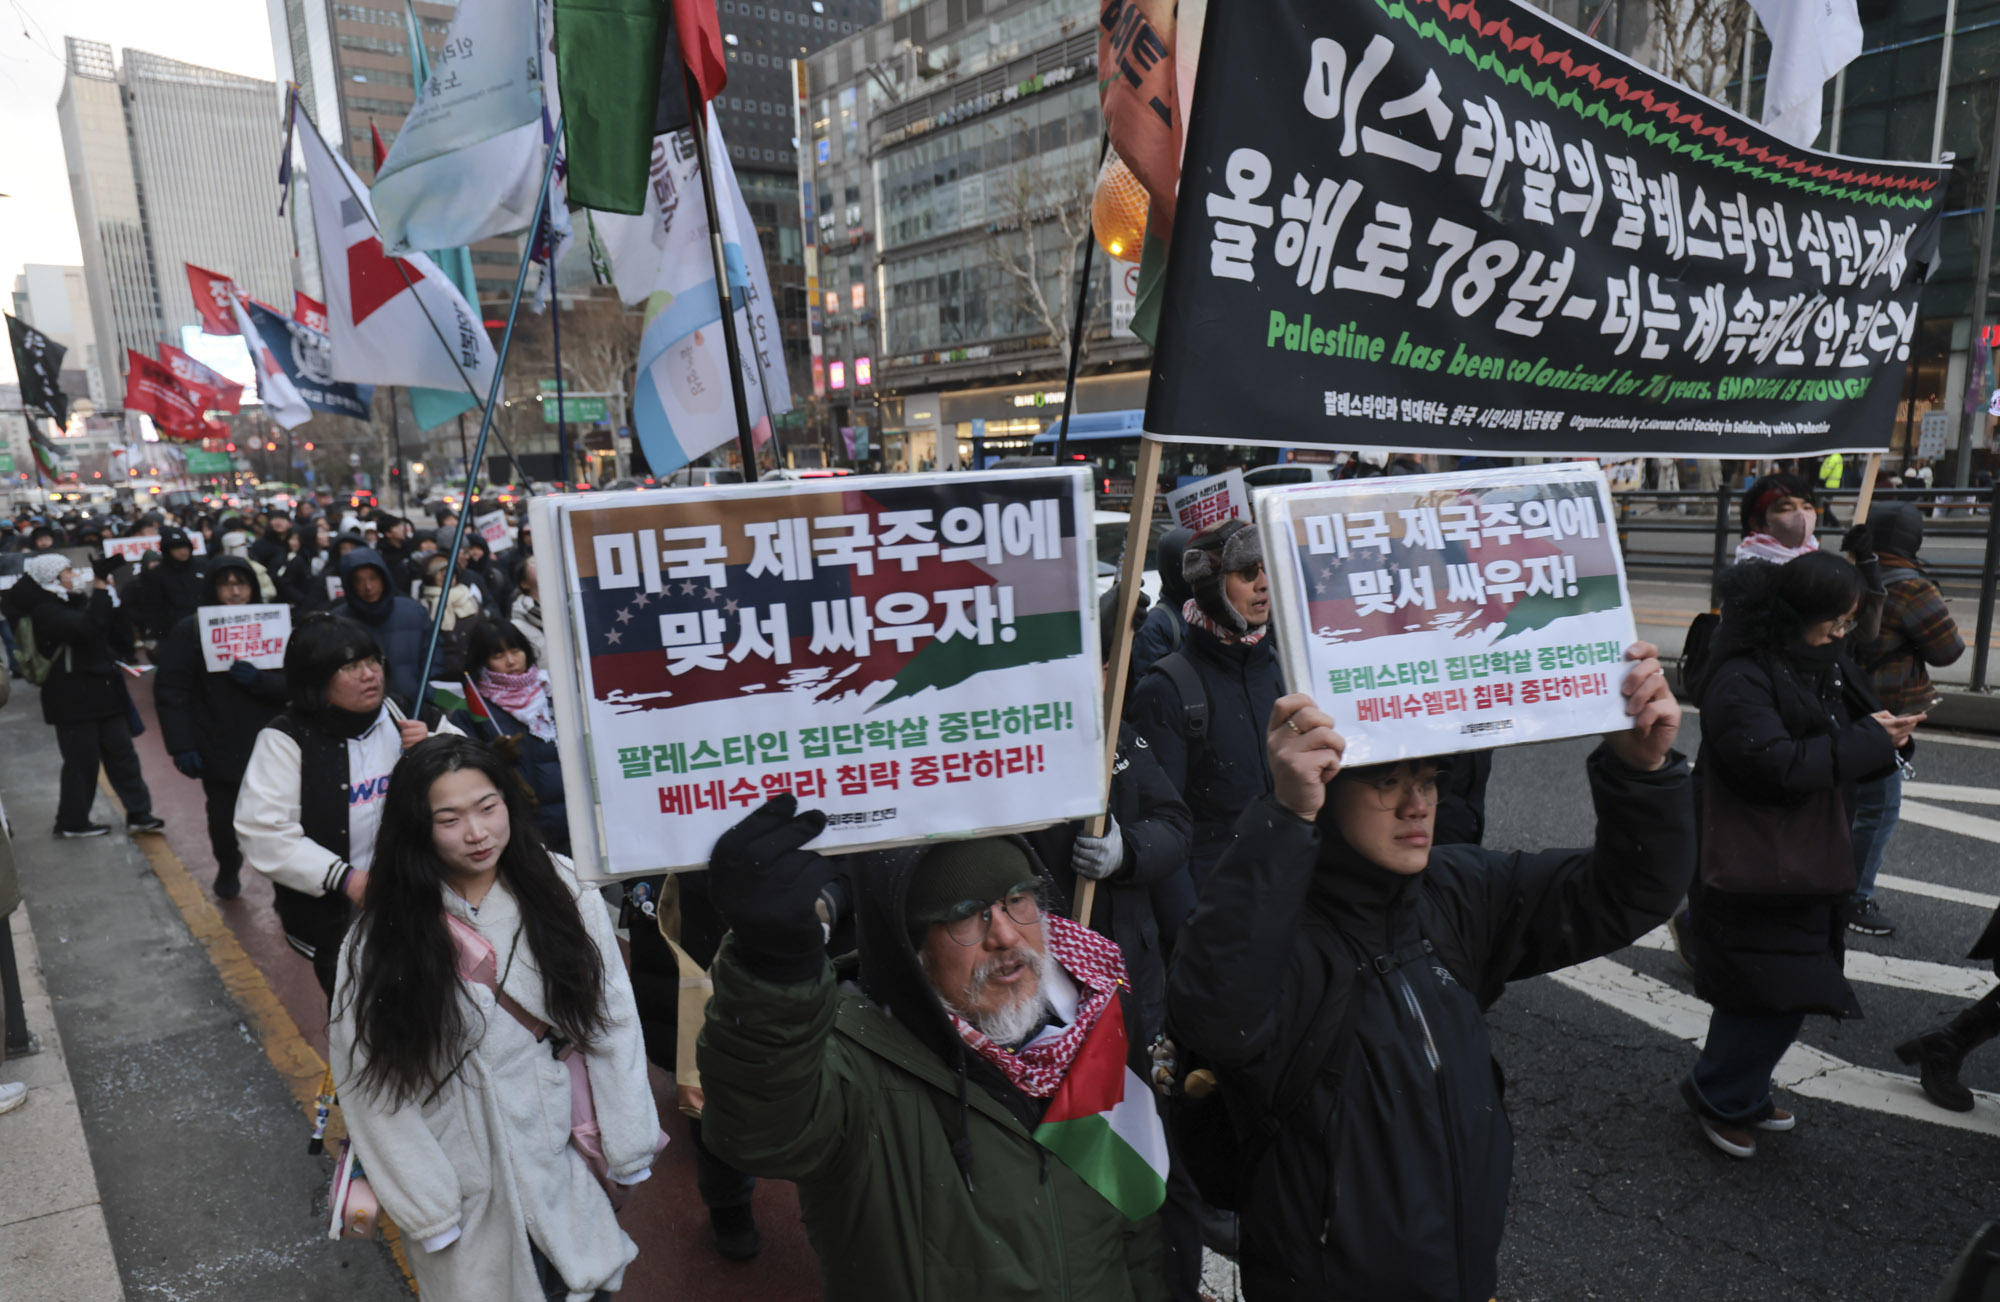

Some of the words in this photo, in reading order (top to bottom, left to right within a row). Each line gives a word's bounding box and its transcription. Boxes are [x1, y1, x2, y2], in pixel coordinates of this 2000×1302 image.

[1304, 34, 1604, 238] 이스라엘의
[1604, 154, 1793, 279] 팔레스타인
[1267, 310, 1385, 362] Palestine
[1391, 331, 1446, 372] has
[1446, 343, 1506, 381] been
[1506, 357, 1618, 392] colonized
[1609, 369, 1643, 396] for
[1779, 379, 1804, 402] IS
[1324, 391, 1398, 421] 팔레스타인과
[1400, 399, 1448, 425] 연대하는
[1449, 405, 1479, 427] 한국
[1476, 408, 1522, 431] 시민사회
[1569, 415, 1600, 431] Urgent
[1599, 416, 1632, 429] Action
[1631, 417, 1641, 433] by
[1675, 418, 1695, 431] Civil
[1694, 420, 1724, 435] Society
[1724, 419, 1733, 433] in
[1733, 421, 1772, 437] Solidarity
[1772, 421, 1796, 434] with
[1192, 464, 1208, 476] 606
[1179, 489, 1231, 523] 트럼프를
[1305, 511, 1392, 560] 미국
[1395, 497, 1598, 551] 제국주의에
[593, 525, 728, 594] 미국
[744, 498, 1062, 583] 제국주의에
[1348, 565, 1437, 618] 맞서
[1446, 553, 1580, 606] 싸우자!
[212, 623, 262, 645] 미국을
[216, 637, 283, 662] 규탄한다
[660, 602, 792, 677] 맞서
[810, 586, 1017, 660] 싸우자!
[1328, 659, 1439, 694] 팔레스타인
[1444, 649, 1532, 682] 집단학살
[1537, 641, 1622, 671] 중단하라!
[1356, 686, 1467, 723] 베네수엘라
[1473, 680, 1514, 709] 침략
[1521, 674, 1608, 704] 중단하라!
[617, 730, 789, 780] 팔레스타인
[799, 716, 930, 758] 집단학살
[938, 701, 1075, 745] 중단하라!
[658, 768, 826, 816] 베네수엘라
[835, 760, 900, 800] 침략
[910, 744, 1045, 788] 중단하라!
